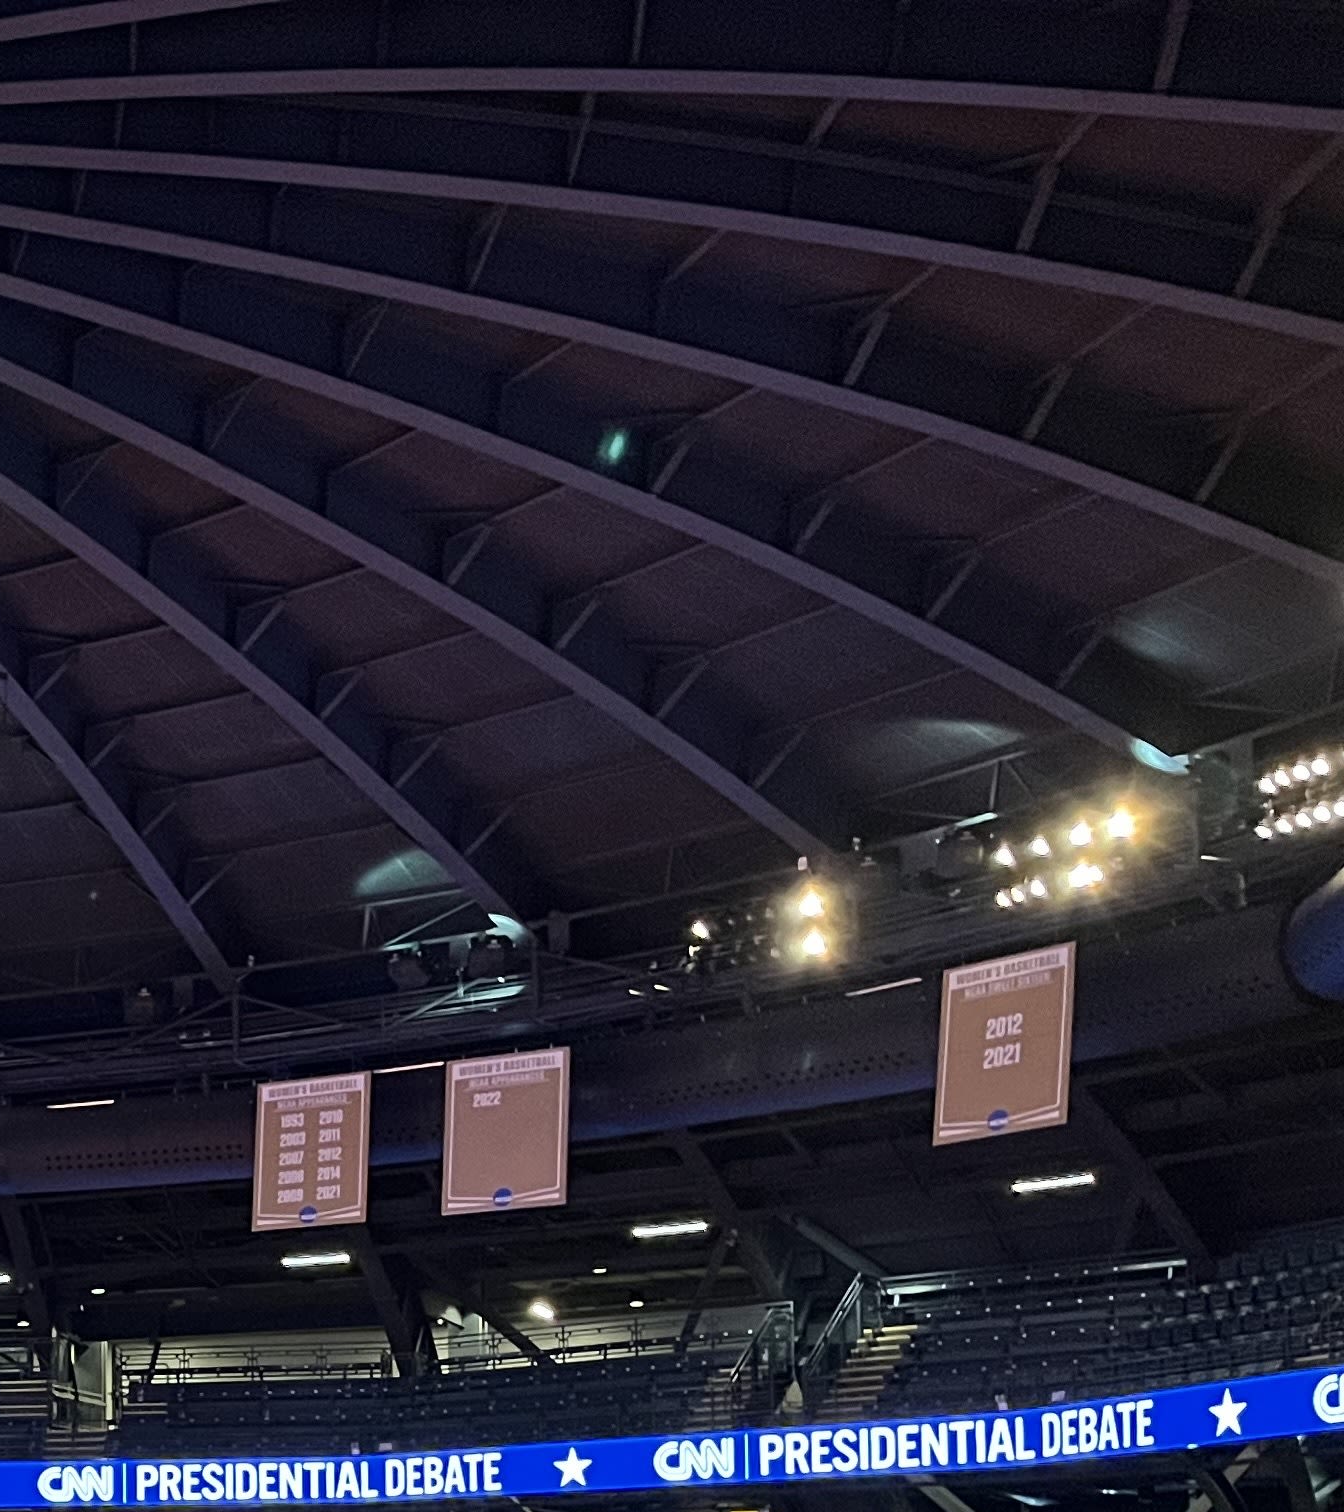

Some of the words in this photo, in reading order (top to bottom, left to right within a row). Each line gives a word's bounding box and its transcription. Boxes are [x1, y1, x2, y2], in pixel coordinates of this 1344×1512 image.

[985, 1012, 1023, 1040] 2012
[983, 1042, 1021, 1069] 2021
[472, 1091, 501, 1108] 2022
[653, 1437, 735, 1481] CNN
[759, 1416, 1036, 1476] PRESIDENTIAL
[1041, 1399, 1155, 1458] DEBATE
[37, 1465, 114, 1503] CNN
[136, 1461, 379, 1501] PRESIDENTIAL
[385, 1452, 502, 1493] DEBATE
